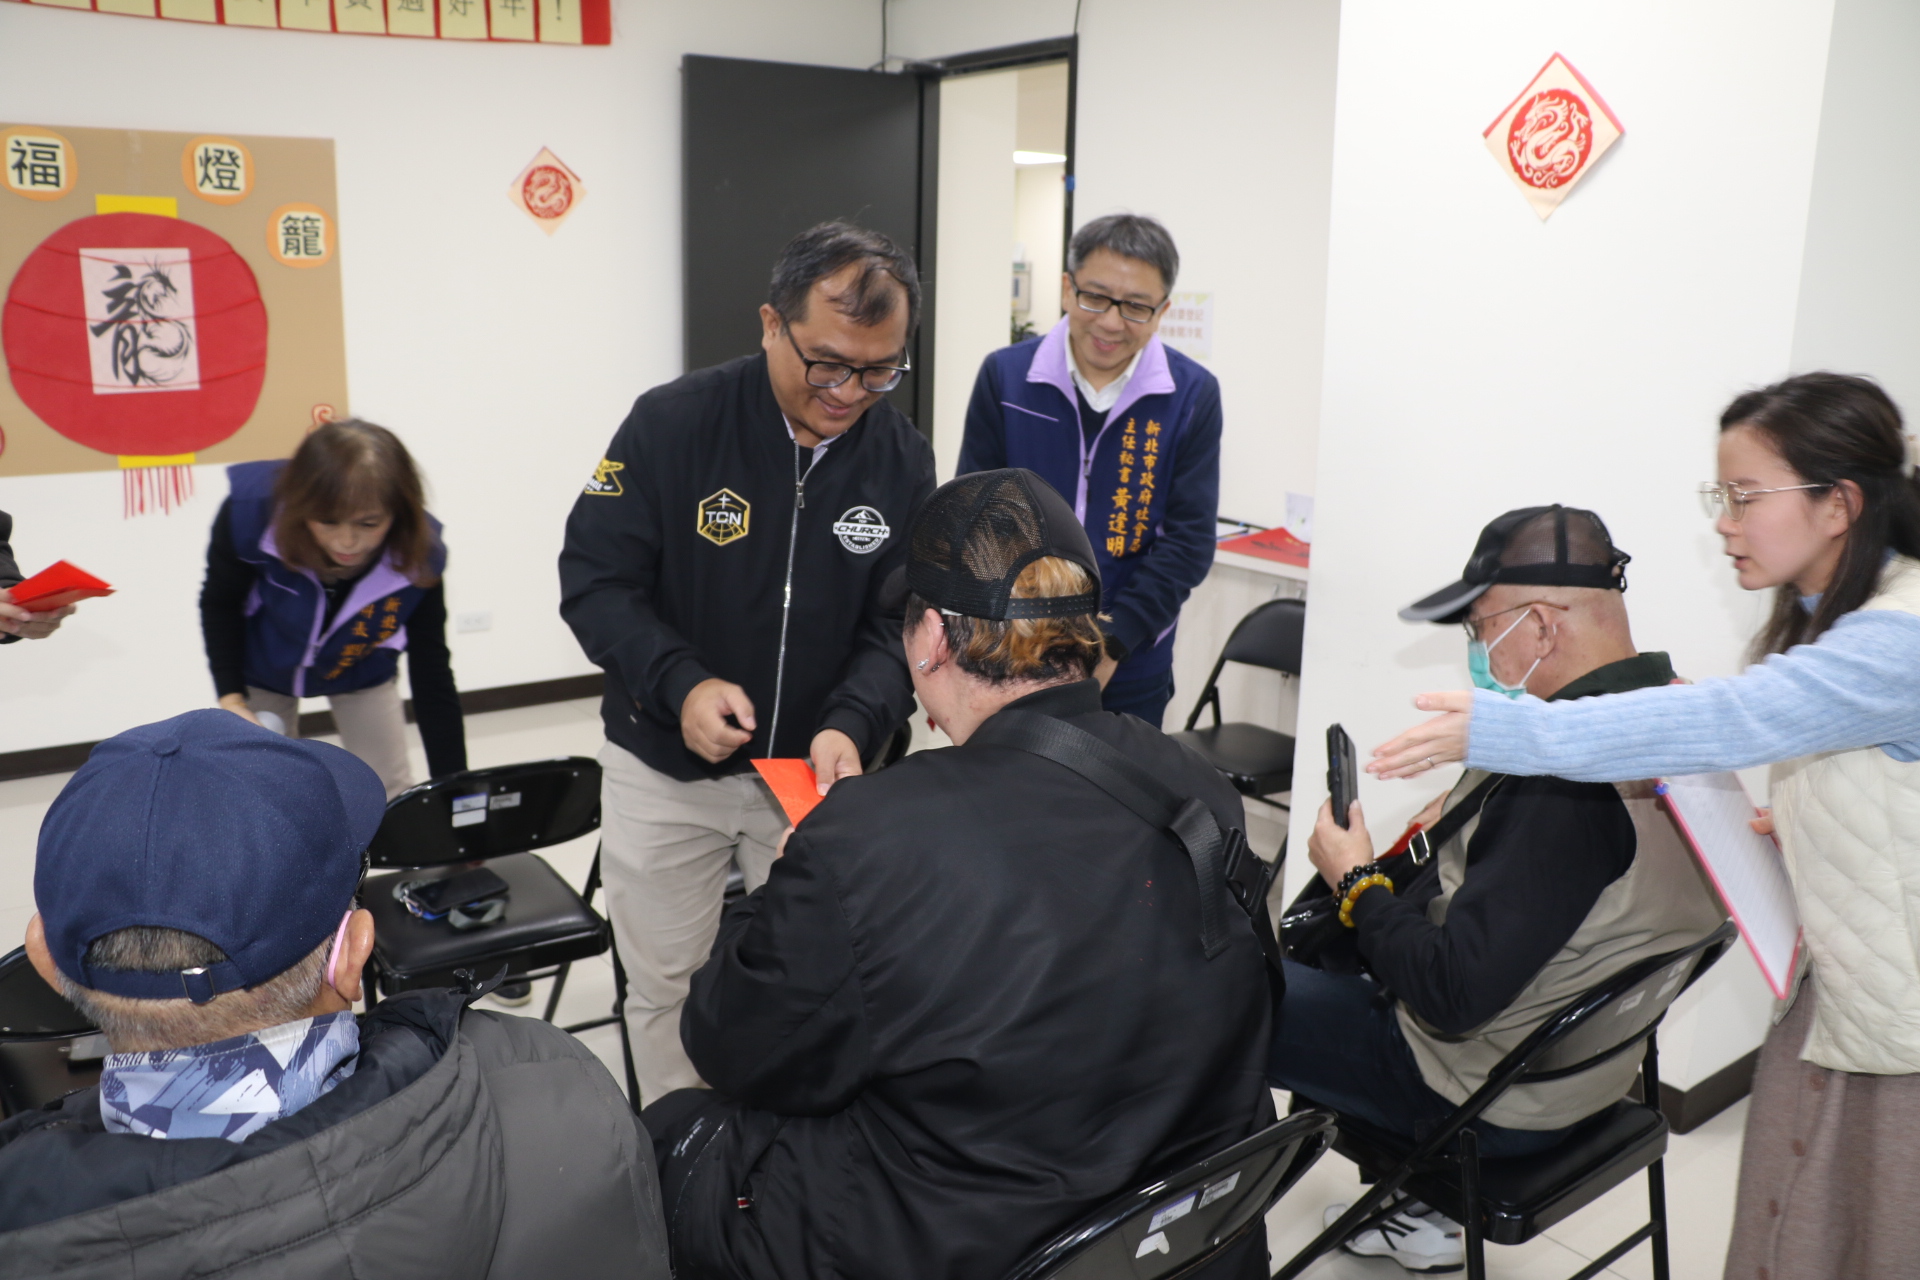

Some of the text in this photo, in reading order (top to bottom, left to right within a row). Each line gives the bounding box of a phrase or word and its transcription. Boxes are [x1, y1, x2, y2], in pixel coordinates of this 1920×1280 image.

[10, 139, 323, 257] 福 燈 籠
[705, 511, 742, 526] TCN
[1129, 419, 1162, 553] 新北市政府社會局
[837, 524, 887, 536] CHURCH
